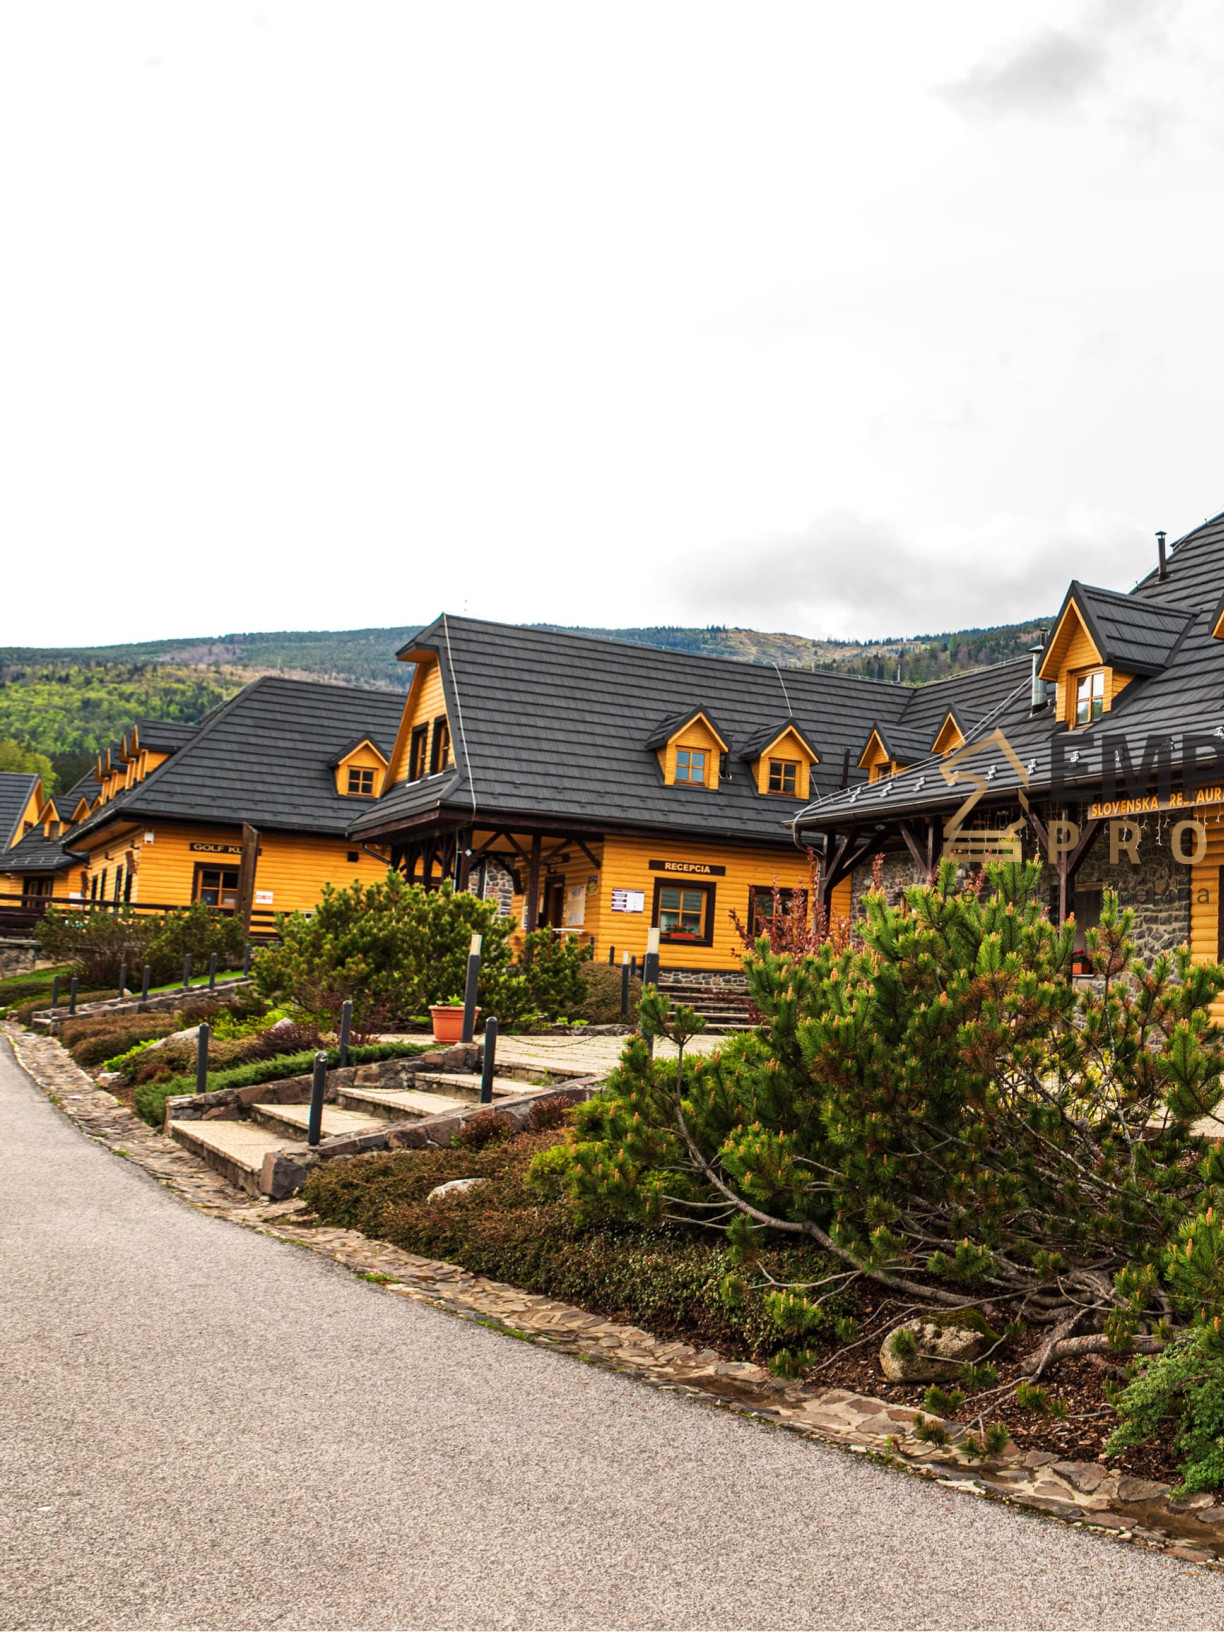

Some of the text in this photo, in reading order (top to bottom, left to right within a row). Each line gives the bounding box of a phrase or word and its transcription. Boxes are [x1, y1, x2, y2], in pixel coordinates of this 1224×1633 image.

[1091, 793, 1159, 818] SLOVENSKÁ
[193, 843, 225, 852] GOLF
[664, 861, 711, 874] RECEPCIA
